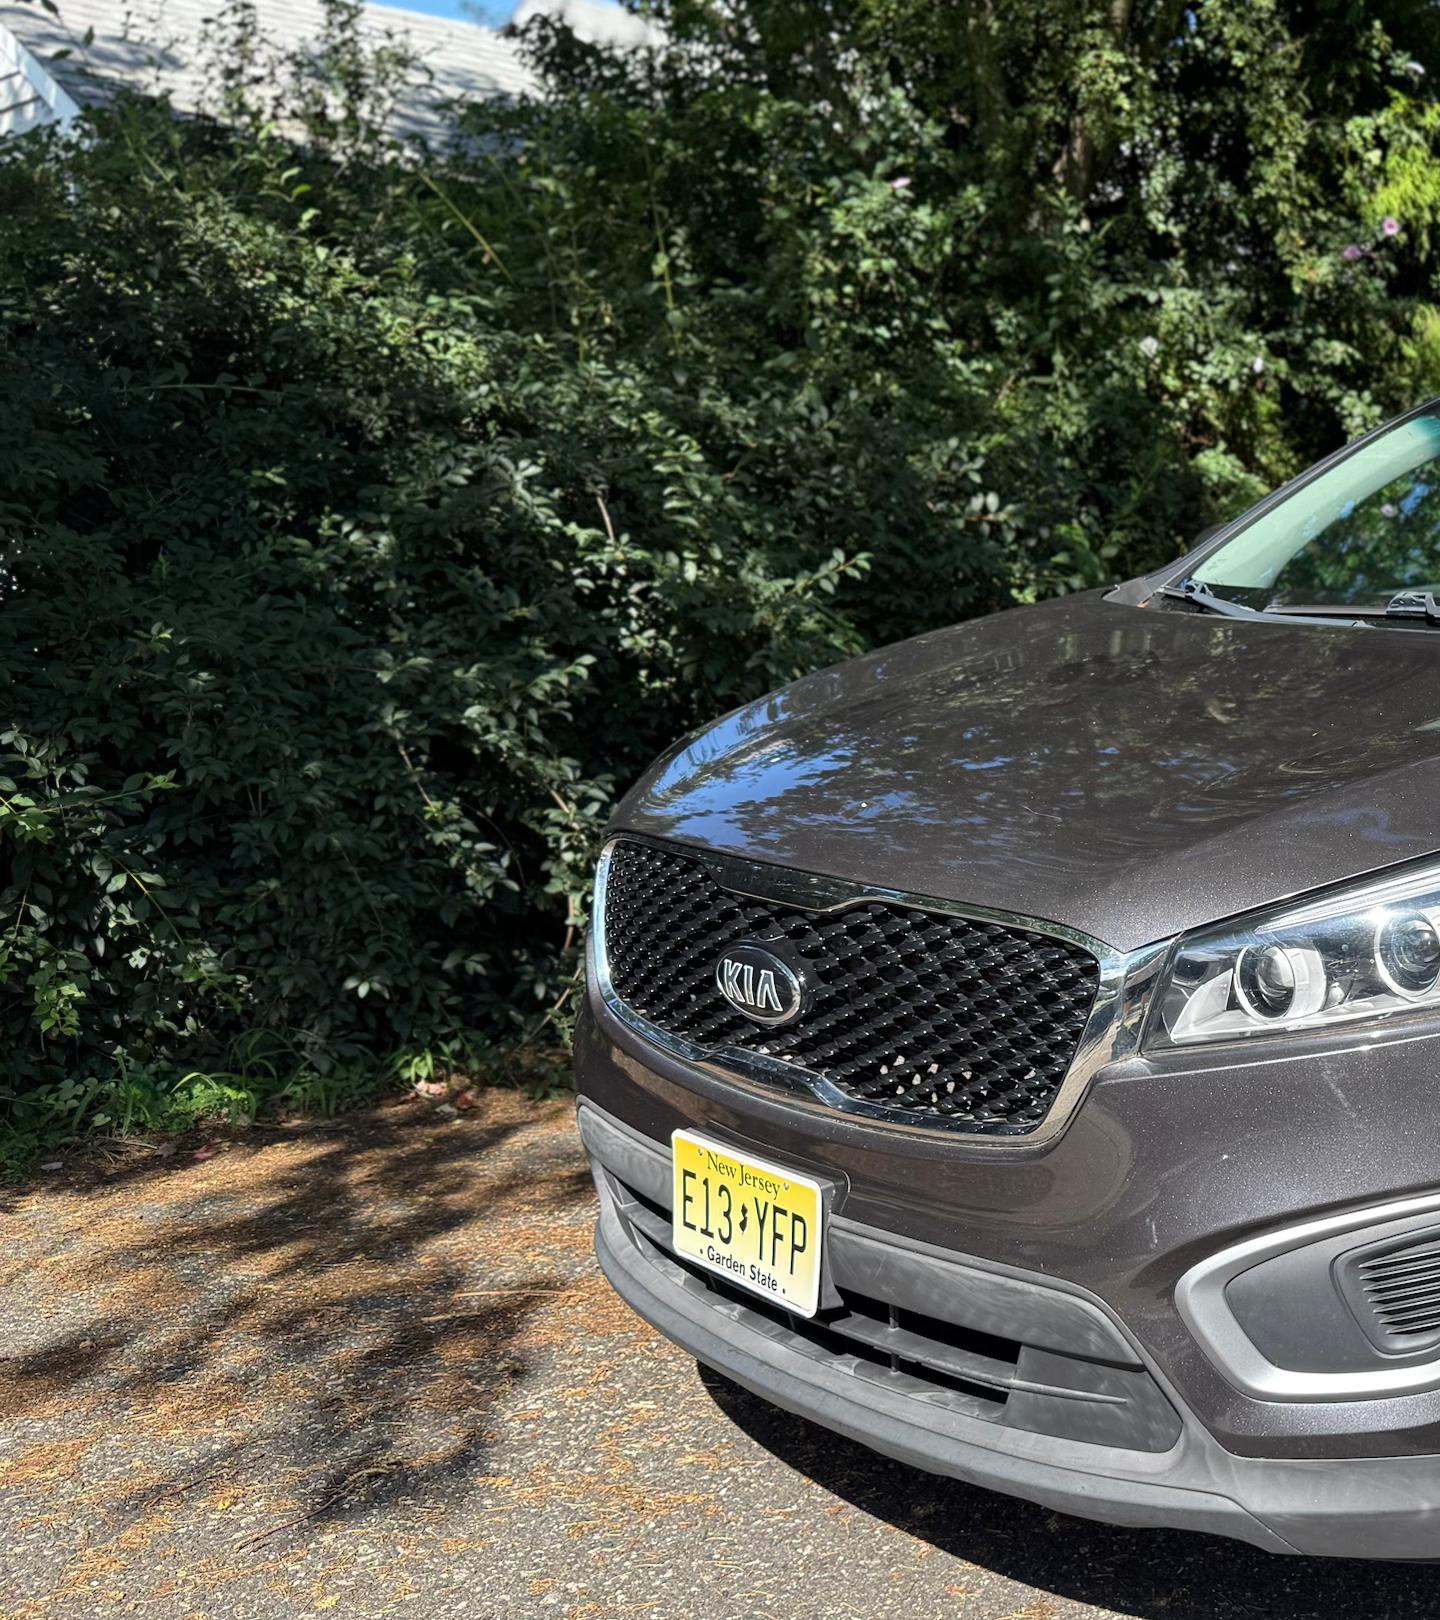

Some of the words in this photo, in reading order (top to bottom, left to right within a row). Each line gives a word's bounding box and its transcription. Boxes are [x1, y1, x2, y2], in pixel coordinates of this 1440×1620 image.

[723, 958, 784, 1012] KIA
[706, 1151, 737, 1179] New
[738, 1164, 781, 1200] Jersey
[682, 1168, 733, 1245] E13
[754, 1197, 808, 1275] YFP
[707, 1245, 746, 1277] Garden
[749, 1264, 778, 1291] State
